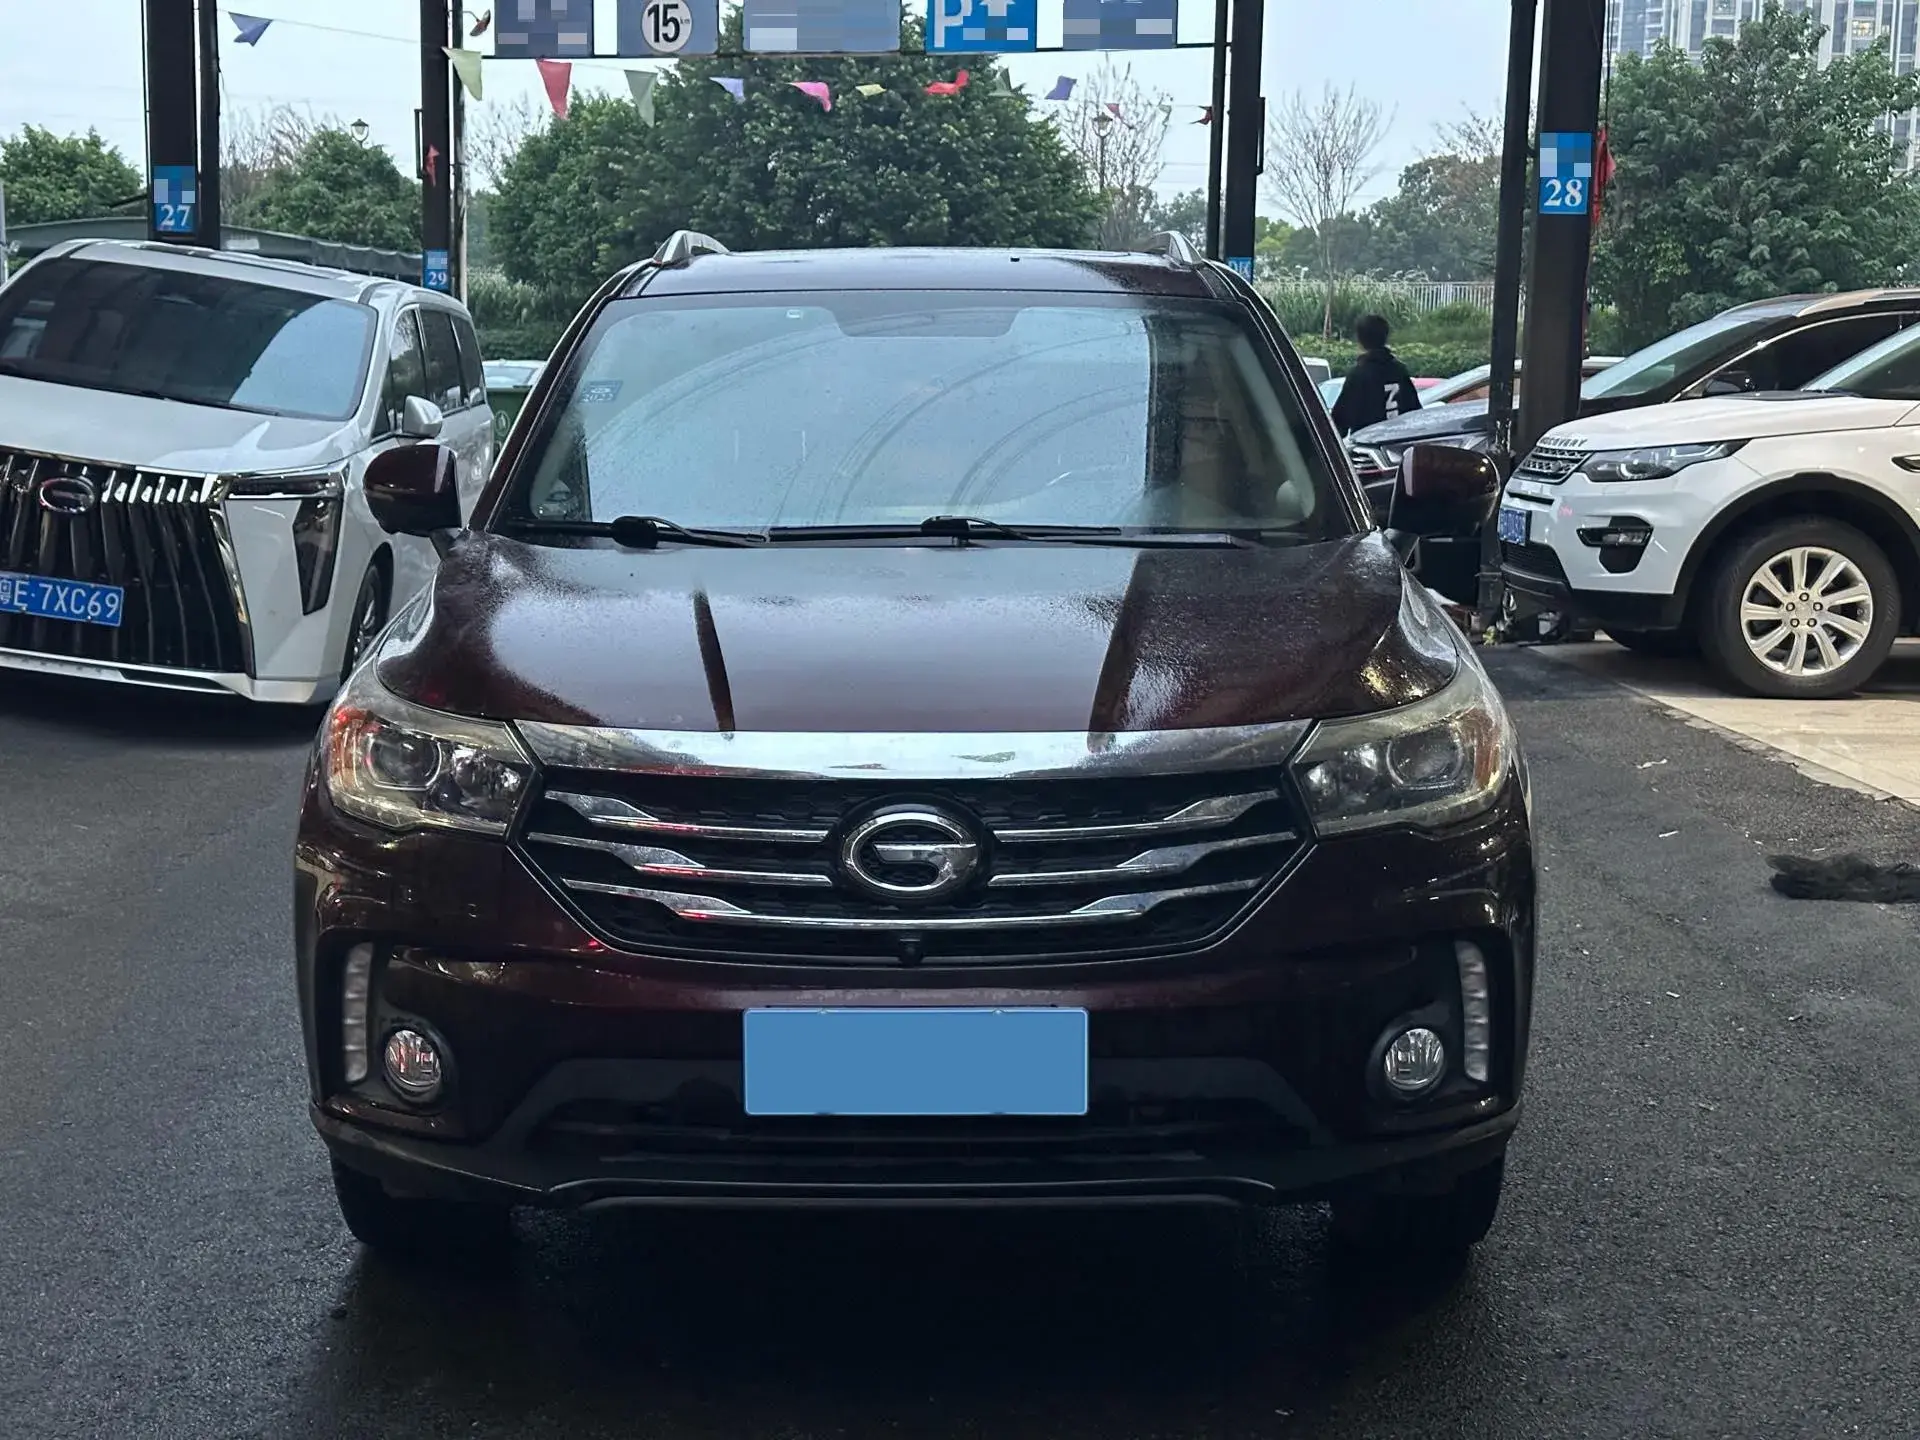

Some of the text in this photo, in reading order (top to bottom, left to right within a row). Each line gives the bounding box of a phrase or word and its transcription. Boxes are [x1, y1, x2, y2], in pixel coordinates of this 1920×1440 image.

[647, 3, 680, 43] 15
[1543, 178, 1583, 208] 28
[160, 204, 191, 227] 27
[428, 271, 447, 286] 29
